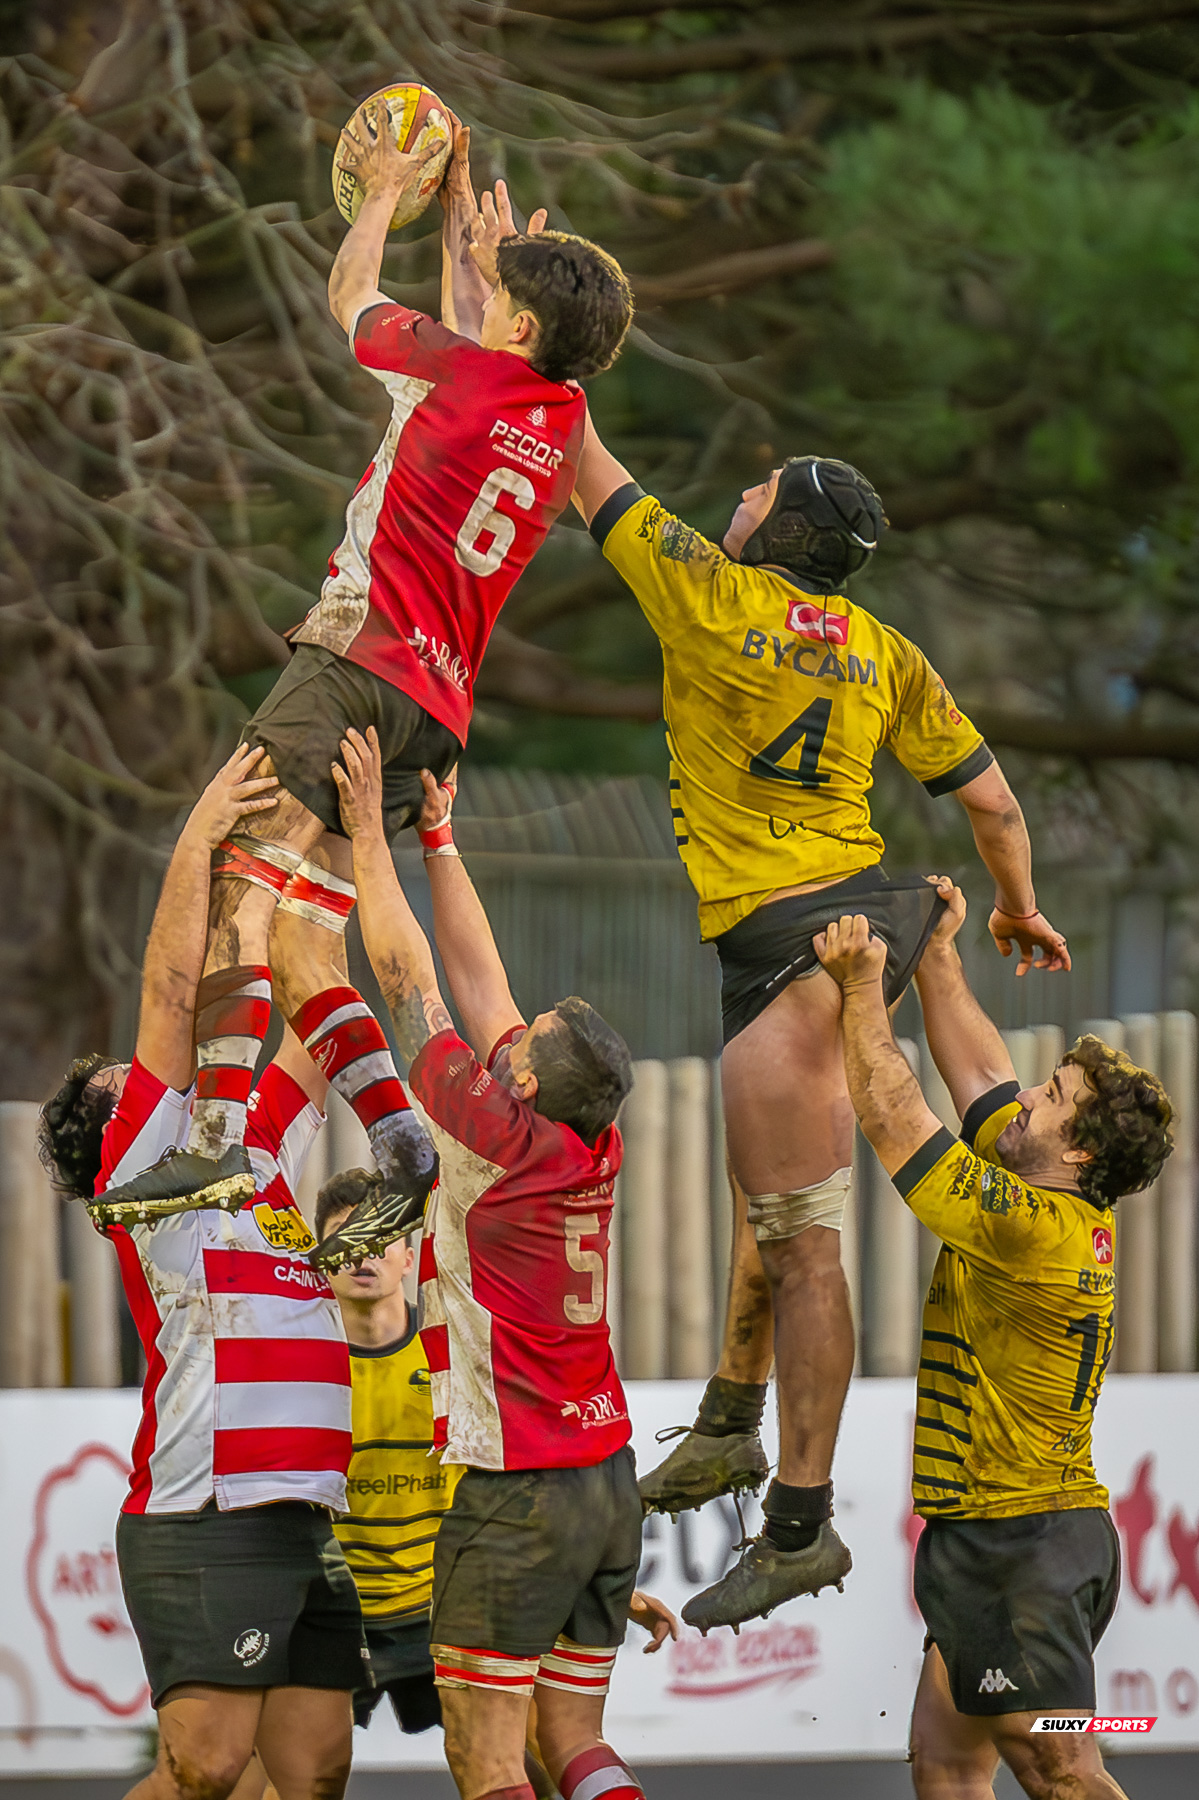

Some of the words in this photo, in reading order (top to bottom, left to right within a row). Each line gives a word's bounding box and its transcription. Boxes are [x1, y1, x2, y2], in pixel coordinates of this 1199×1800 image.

[489, 419, 564, 471] PECOR
[455, 467, 535, 577] 6
[741, 628, 878, 687] BYCAM
[749, 697, 833, 788] 4
[564, 1212, 604, 1325] 5
